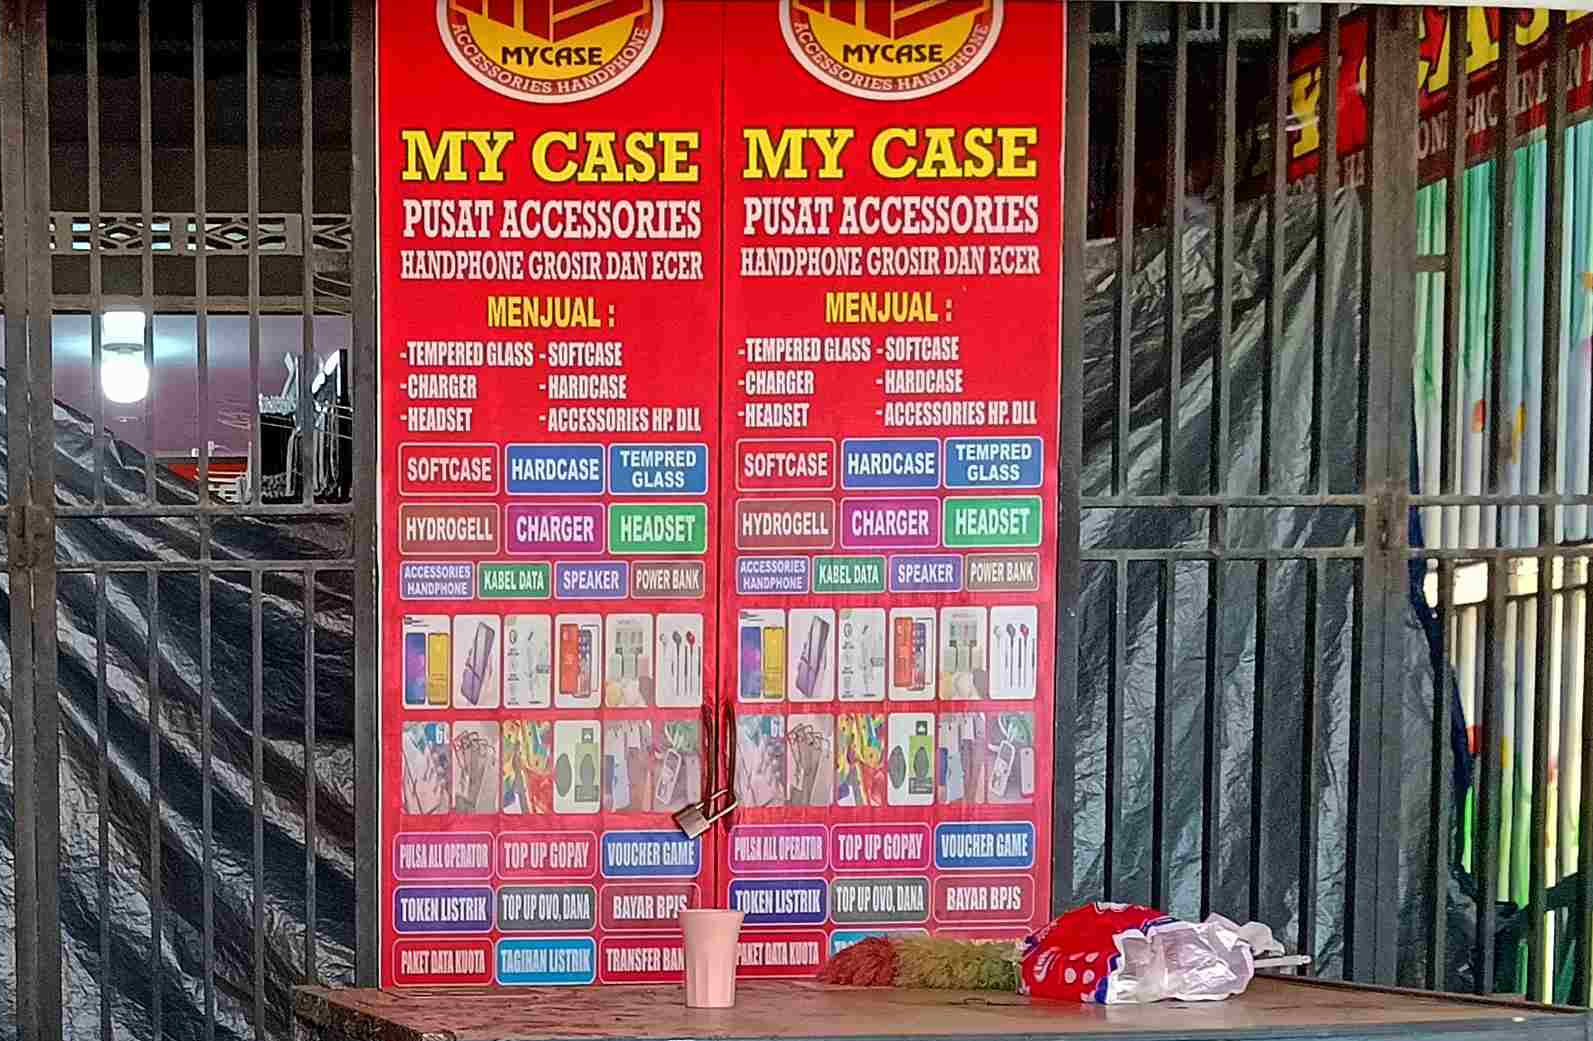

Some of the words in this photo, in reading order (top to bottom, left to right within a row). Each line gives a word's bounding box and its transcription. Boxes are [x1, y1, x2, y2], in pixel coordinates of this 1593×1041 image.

[452, 23, 553, 95] ACCESSORIES
[558, 27, 649, 94] HANDPHONE
[501, 46, 602, 66] MYCASE
[793, 21, 894, 91] ACCESSORIES
[898, 23, 990, 89] HANDPHONE
[843, 44, 942, 64] MYCASE
[402, 131, 513, 181] MY
[532, 131, 699, 182] CASE
[744, 128, 854, 178] MY
[871, 128, 1037, 179] CASE
[403, 200, 493, 238] PUSAT
[502, 199, 702, 239] ACCESSORIES
[744, 197, 832, 235] PUSAT
[839, 196, 1039, 235] ACCESSORIES
[401, 250, 523, 279] HANDPHONE
[529, 250, 602, 280] GROSIR
[606, 251, 647, 279] DAN
[652, 251, 703, 279] ECER
[741, 246, 862, 276] HANDPHONE
[867, 246, 941, 275] GROSIR
[945, 246, 985, 275] DAN
[989, 246, 1040, 274] ECER
[488, 296, 601, 327] MENJUAL
[826, 292, 938, 322] MENJUAL
[487, 342, 533, 366] GLASS
[824, 337, 871, 361] GLASS
[676, 408, 701, 432] DLL
[1012, 401, 1037, 425] DLL
[620, 450, 697, 467] TEMPRED
[848, 453, 935, 475] HARDCASE
[956, 444, 1032, 460] TEMPRED
[407, 457, 492, 482] SOFTCASE
[511, 459, 600, 481] HARDCASE
[744, 453, 828, 477] SOFTCASE
[967, 464, 1020, 481] GLASS
[632, 471, 685, 488] GLASS
[406, 517, 493, 541] HYDROGELL
[516, 516, 594, 542] CHARGER
[621, 515, 696, 542] HEADSET
[742, 512, 828, 535] HYDROGELL
[852, 510, 929, 536] CHARGER
[955, 508, 1030, 535] HEADSET
[404, 565, 470, 579] ACCESSORIES
[740, 560, 806, 573] ACCESSORIES
[819, 565, 852, 584] KABEL
[854, 565, 879, 584] DATA
[898, 564, 953, 584] SPEAKER
[969, 562, 1004, 582] POWER
[1006, 561, 1033, 582] BANK
[484, 570, 517, 590] KABEL
[519, 571, 544, 590] DATA
[563, 571, 619, 590] SPEAKER
[636, 570, 671, 590] POWER
[673, 570, 700, 590] BANK
[743, 576, 803, 590] HANDPHONE
[444, 843, 488, 868] OPERATOR
[504, 843, 527, 869] TOP
[530, 843, 548, 868] UP
[551, 842, 589, 868] GOPAY
[608, 842, 661, 866] VOUCHER
[663, 841, 695, 865] GAME
[779, 836, 823, 860] OPERATOR
[838, 835, 861, 860] TOP
[864, 835, 882, 860] UP
[884, 834, 922, 860] GOPAY
[941, 834, 994, 858] VOUCHER
[996, 834, 1028, 857] GAME
[401, 898, 439, 921] TOKEN
[441, 897, 487, 921] LISTRIK
[502, 894, 521, 920] TOP
[523, 894, 536, 919] UP
[563, 894, 590, 919] DANA
[613, 896, 654, 919] BAYAR
[735, 890, 774, 914] TOKEN
[775, 889, 821, 913] LISTRIK
[837, 886, 855, 912] TOP
[857, 886, 871, 911] UP
[897, 886, 924, 911] DANA
[946, 887, 988, 911] BAYAR
[990, 886, 1021, 910] BPJS
[455, 950, 485, 974] KUOTA
[548, 948, 591, 972] LISTRIK
[606, 948, 660, 972] TRANSFER
[662, 948, 684, 971] BAN
[789, 942, 819, 965] KUOTA
